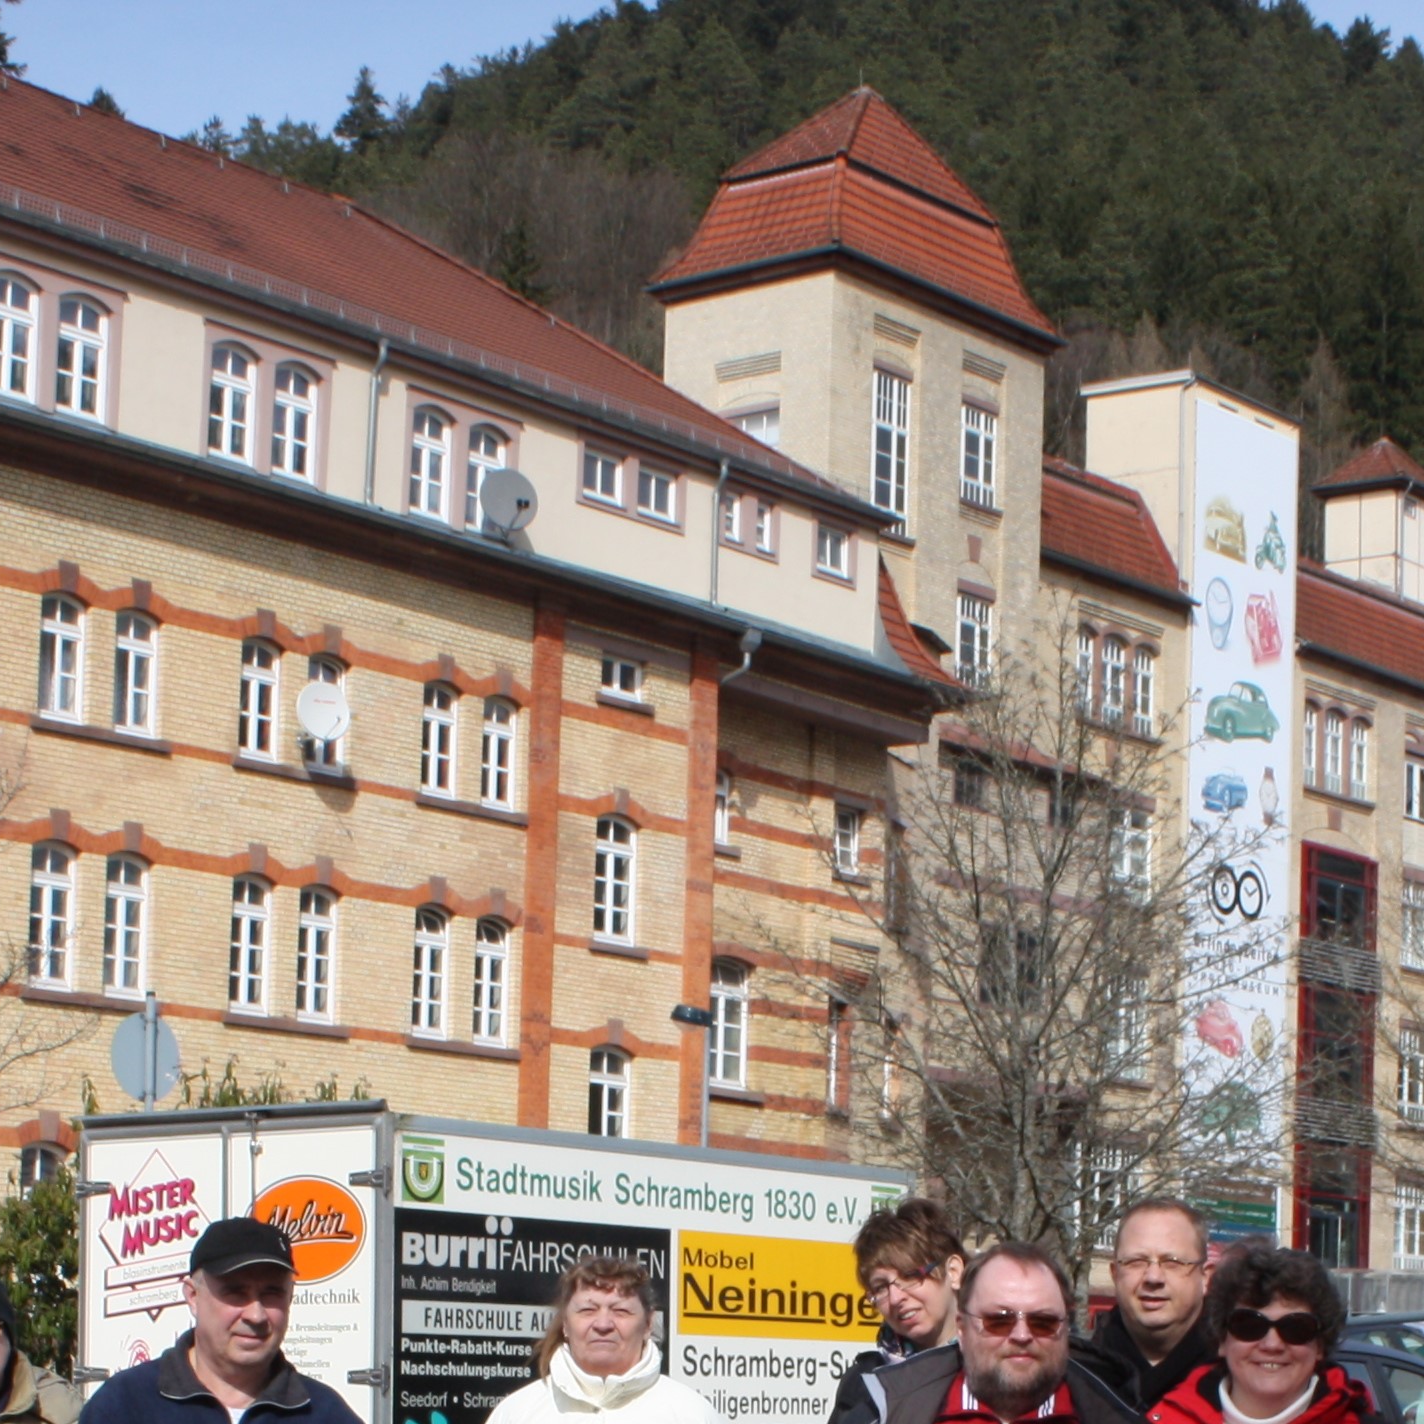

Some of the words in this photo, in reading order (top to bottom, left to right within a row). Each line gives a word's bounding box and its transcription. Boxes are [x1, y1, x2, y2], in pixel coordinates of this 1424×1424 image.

[455, 1157, 602, 1202] Stadtmusik
[615, 1172, 754, 1223] Schramberg
[764, 1188, 816, 1222] 1830
[826, 1196, 863, 1226] e.V.
[268, 1198, 356, 1246] Melvin
[683, 1247, 754, 1270] Möbel
[291, 1288, 361, 1305] adtechnik
[401, 1275, 416, 1289] Inh.
[420, 1277, 449, 1291] Achim
[451, 1278, 497, 1296] Bendigkeit
[683, 1272, 880, 1328] Neininge
[424, 1307, 523, 1331] FAHRSCHULE
[401, 1337, 532, 1356] Punkte-Rabatt-Kurse
[401, 1360, 531, 1380] Nachschulungskurse
[400, 1390, 448, 1408] Seedorf
